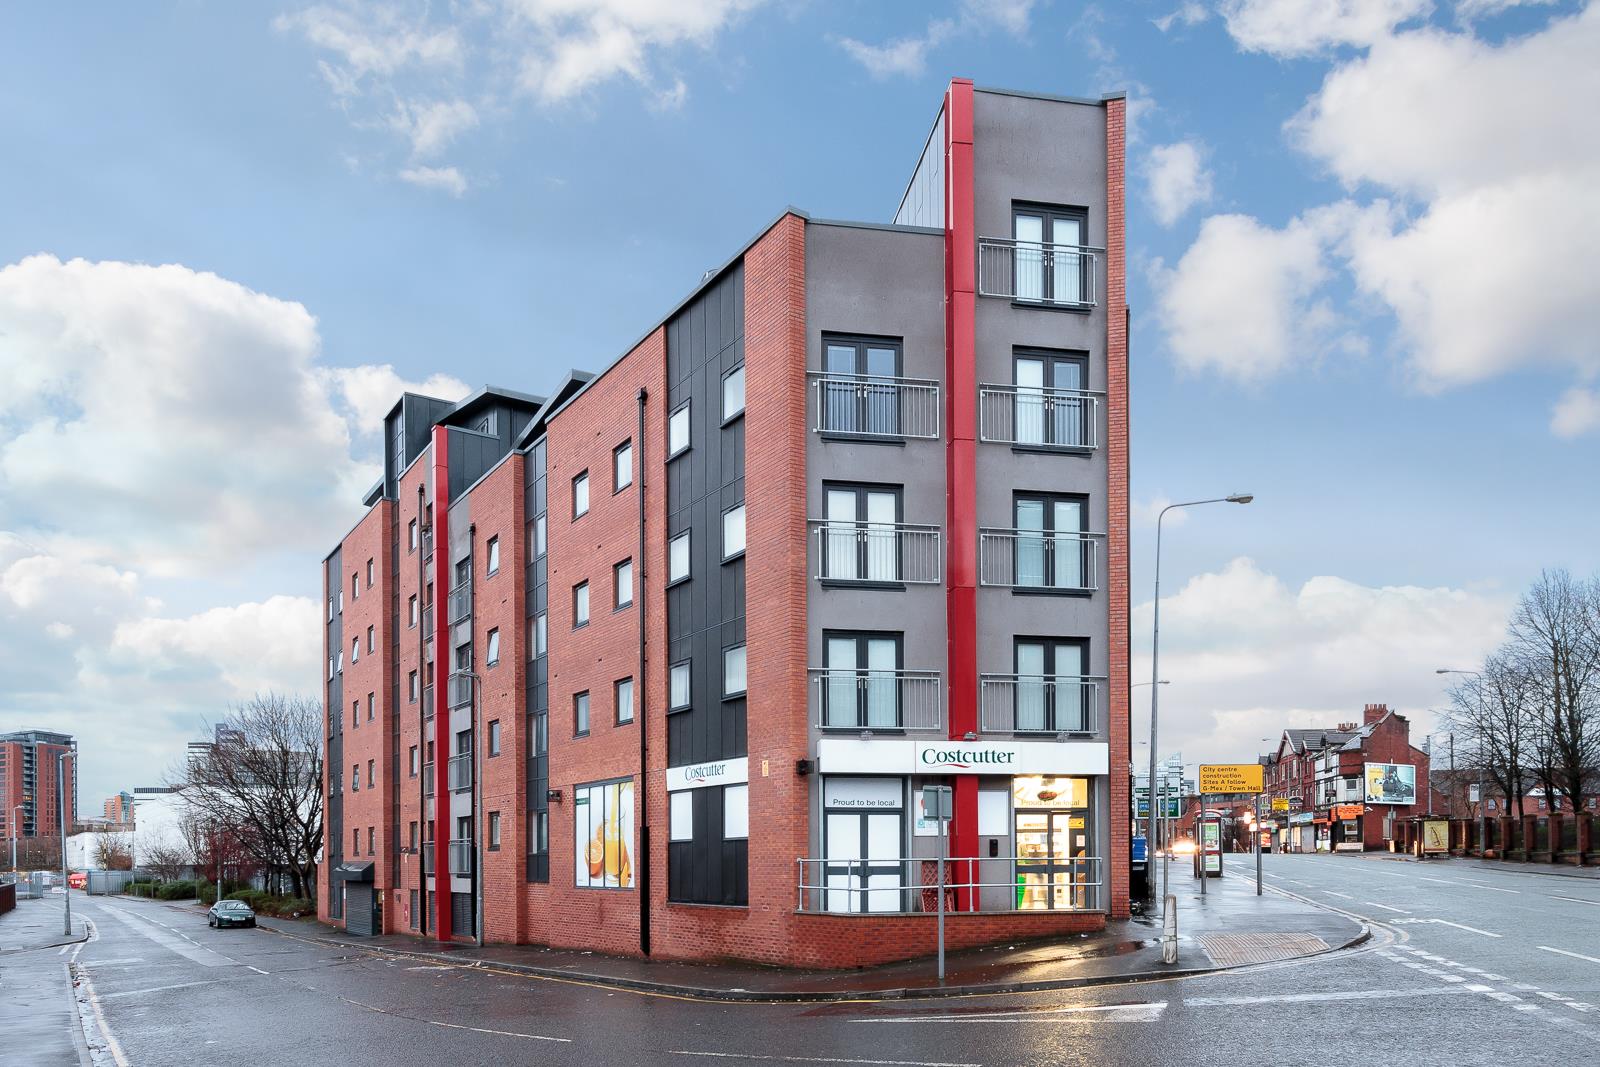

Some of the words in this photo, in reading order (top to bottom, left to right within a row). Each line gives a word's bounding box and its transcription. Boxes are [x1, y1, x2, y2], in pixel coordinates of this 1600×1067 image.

[922, 748, 1015, 765] Costcutter
[684, 763, 726, 782] Costcutter
[832, 798, 855, 806] Proud
